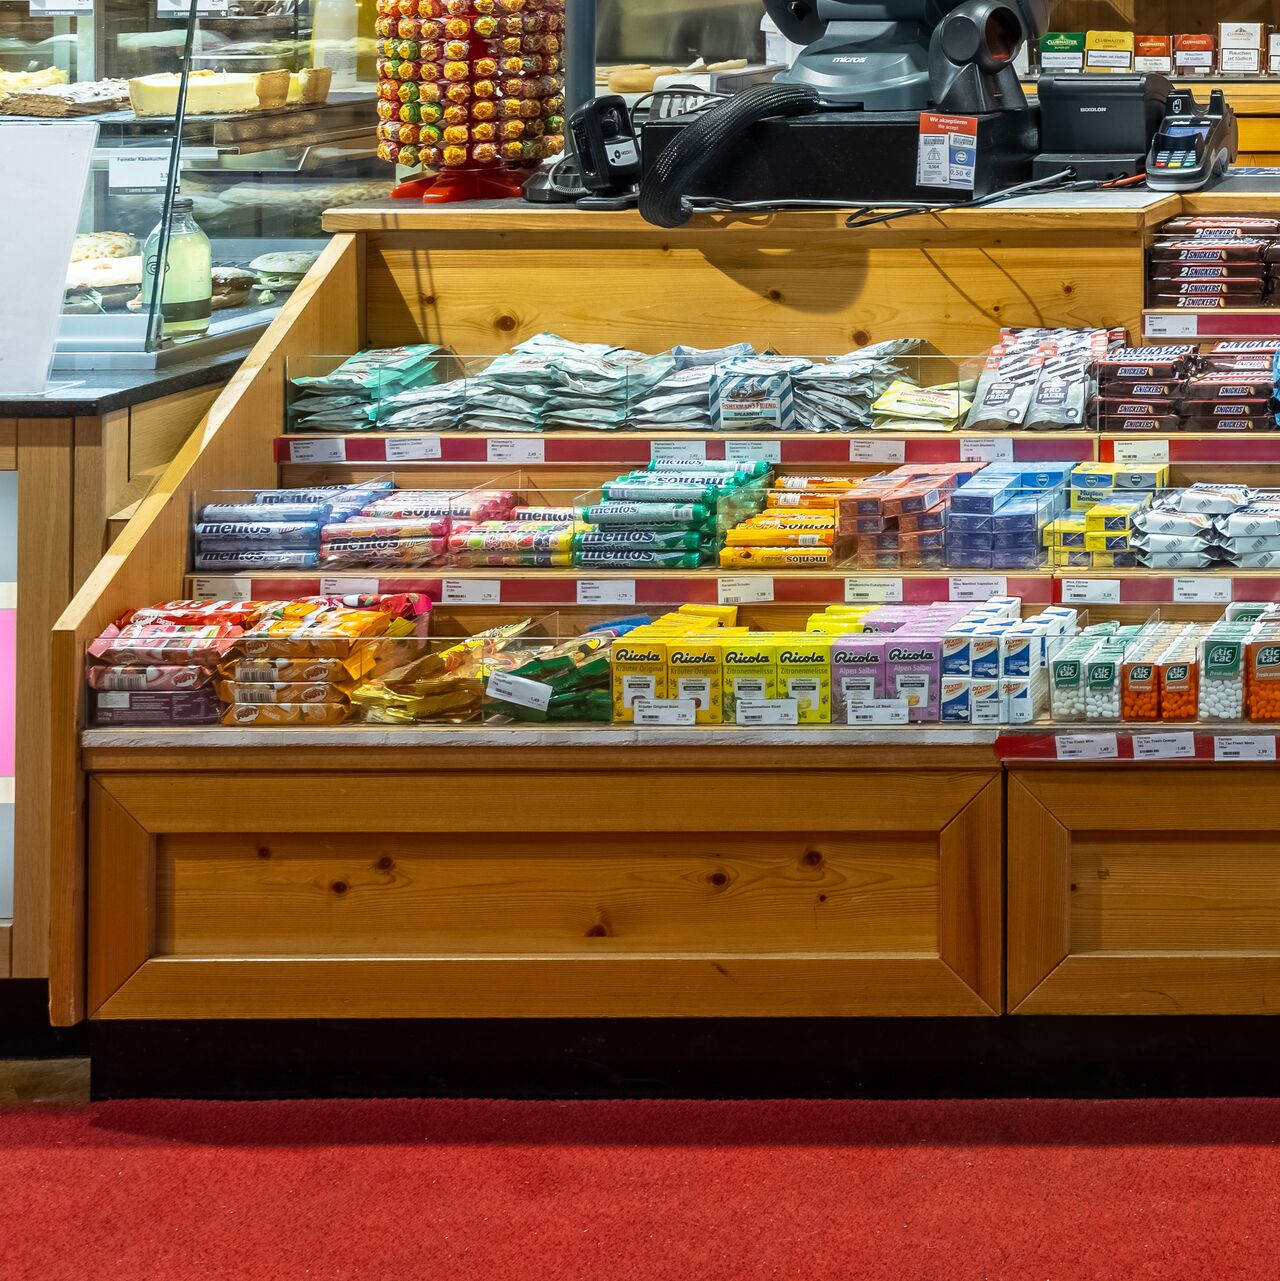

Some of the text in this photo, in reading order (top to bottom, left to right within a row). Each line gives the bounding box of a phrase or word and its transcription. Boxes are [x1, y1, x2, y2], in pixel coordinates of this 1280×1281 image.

[1188, 251, 1221, 260] SNICKERS
[582, 531, 655, 543] mentos
[671, 652, 716, 664] Ricola
[1214, 654, 1231, 662] tac
